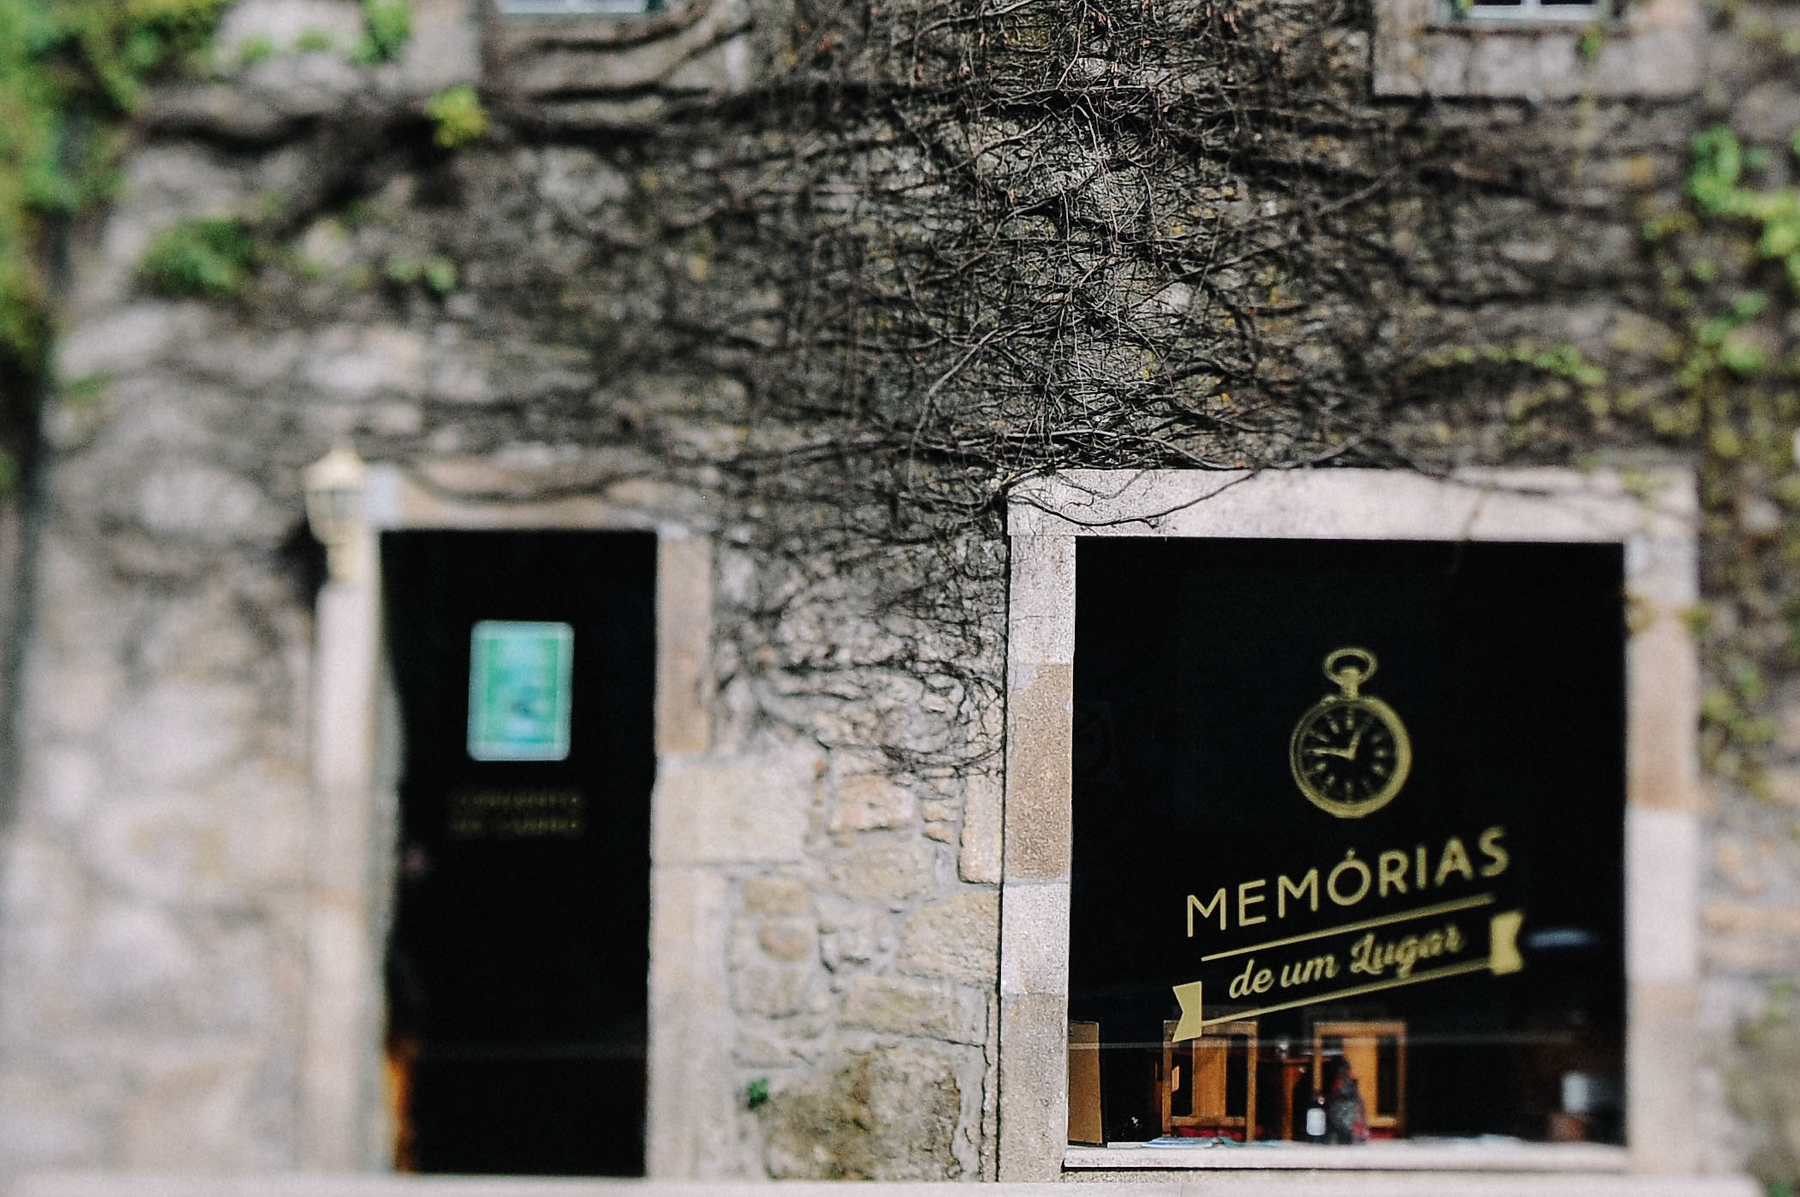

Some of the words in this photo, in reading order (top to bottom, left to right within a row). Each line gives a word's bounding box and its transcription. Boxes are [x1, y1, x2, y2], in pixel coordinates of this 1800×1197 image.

[1186, 827, 1509, 938] MEMÓRIAS
[1228, 959, 1274, 1000] de
[1280, 953, 1337, 988] um
[1349, 926, 1464, 981] Lugar
